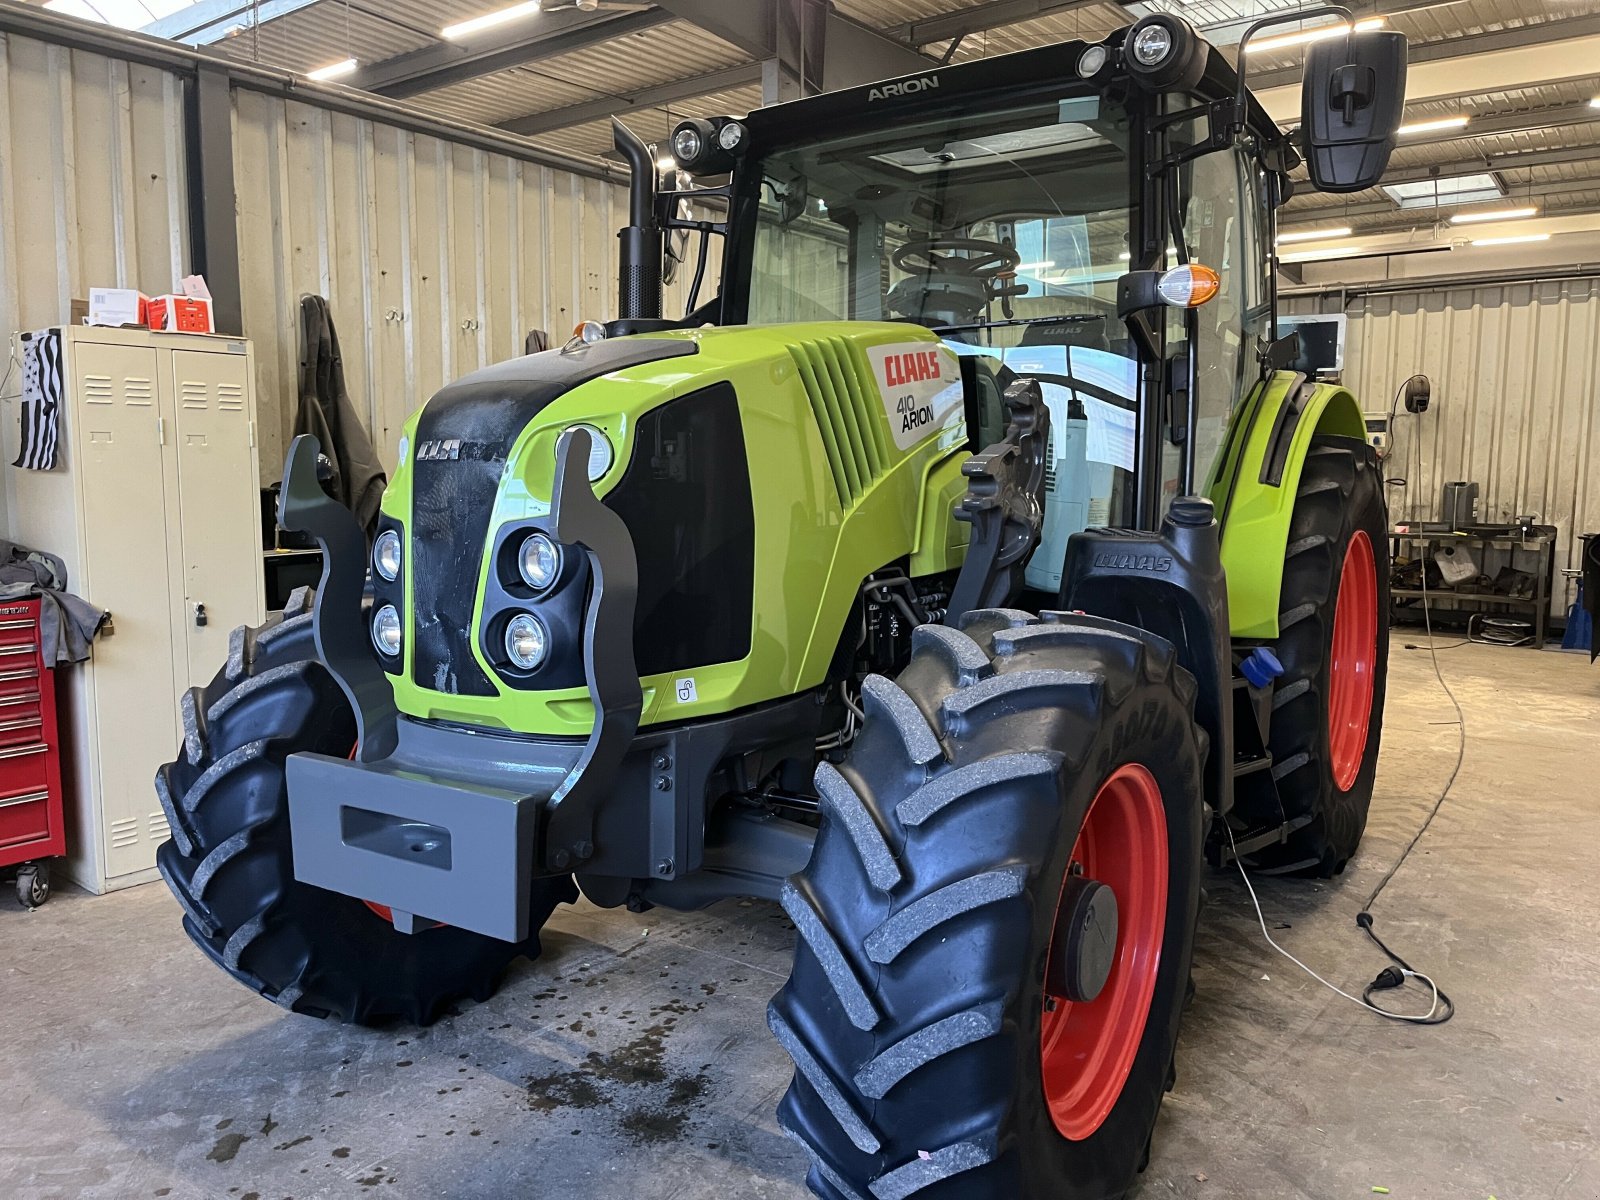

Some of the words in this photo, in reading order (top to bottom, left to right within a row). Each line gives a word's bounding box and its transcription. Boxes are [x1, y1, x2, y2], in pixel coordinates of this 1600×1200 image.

[868, 75, 939, 102] ARION
[1042, 326, 1084, 335] CLAAS
[884, 351, 941, 388] CLAAS
[896, 394, 915, 415] 410
[902, 404, 934, 434] ARION
[1094, 553, 1172, 572] CLAAS
